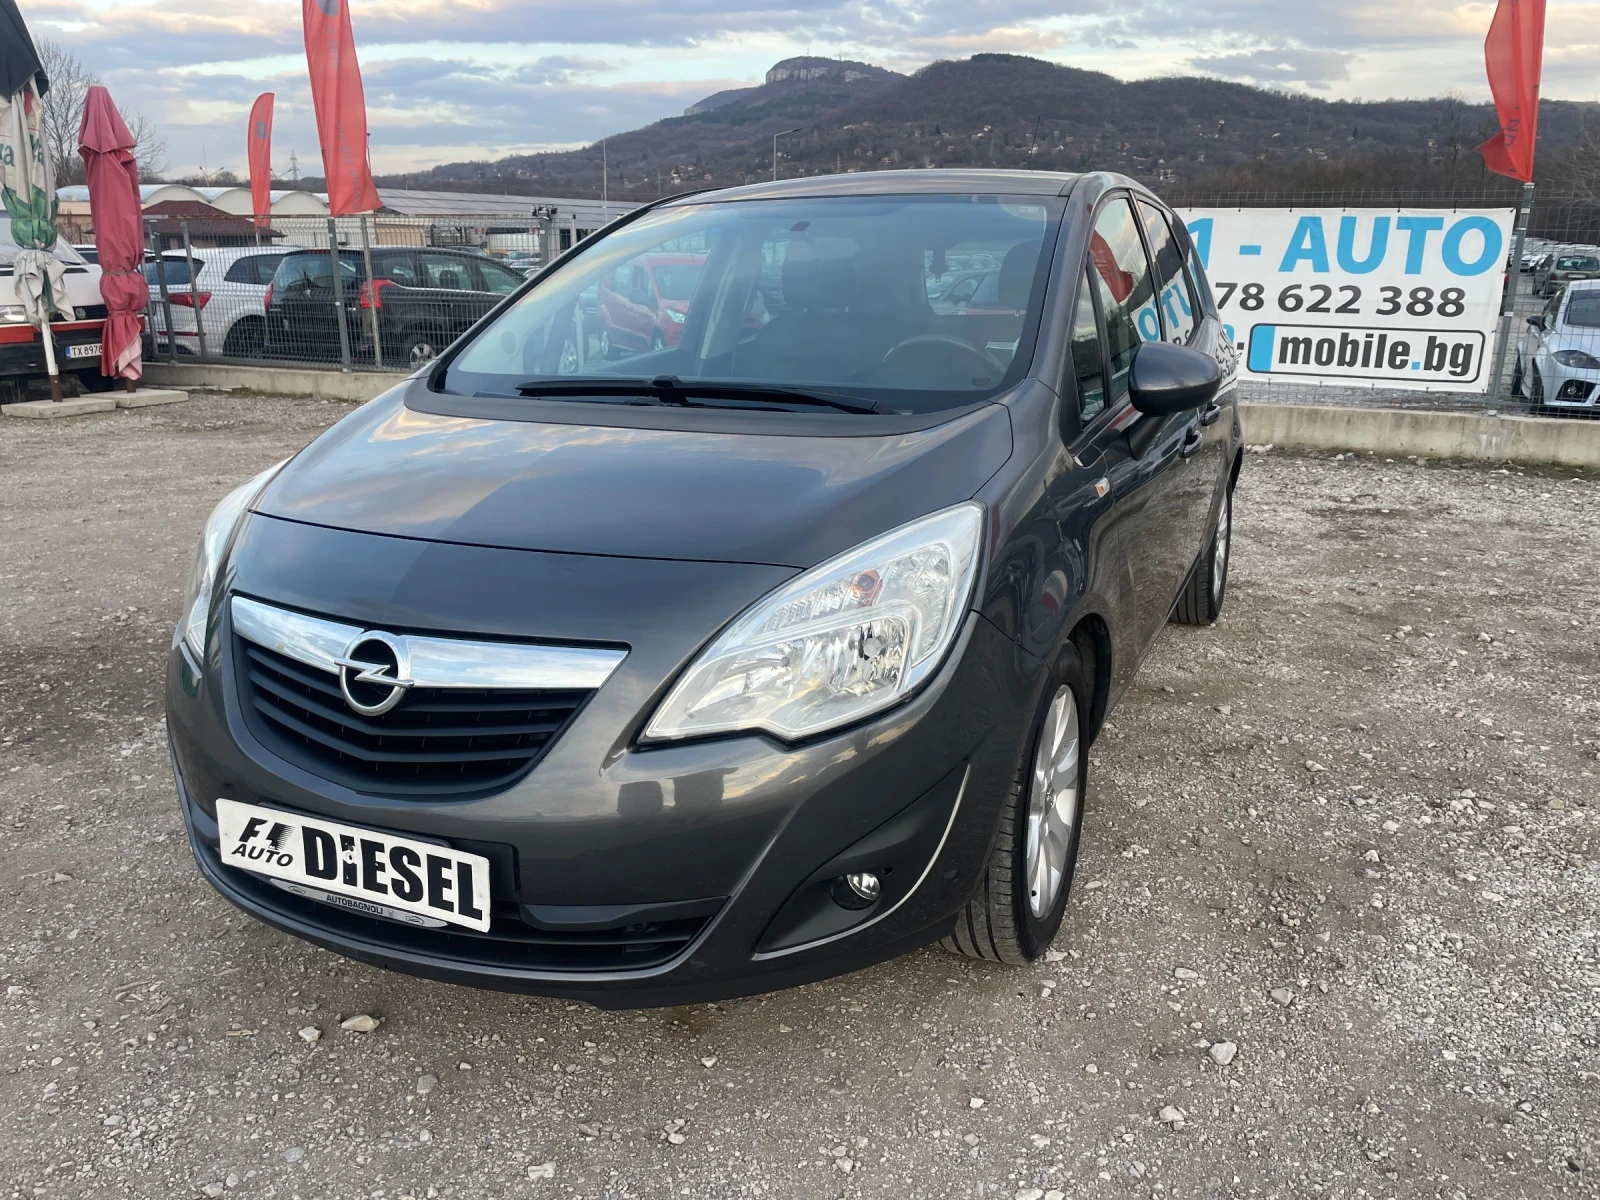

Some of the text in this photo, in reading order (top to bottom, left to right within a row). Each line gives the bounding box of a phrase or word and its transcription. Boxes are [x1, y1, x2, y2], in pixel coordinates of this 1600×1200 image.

[1278, 216, 1503, 276] AUTO
[1278, 283, 1362, 315] 622
[1375, 285, 1466, 318] 388
[71, 346, 83, 357] TX
[1279, 333, 1473, 377] mobile.bg
[231, 843, 294, 868] AUTO
[326, 894, 384, 916] AUTOBAGNOLI
